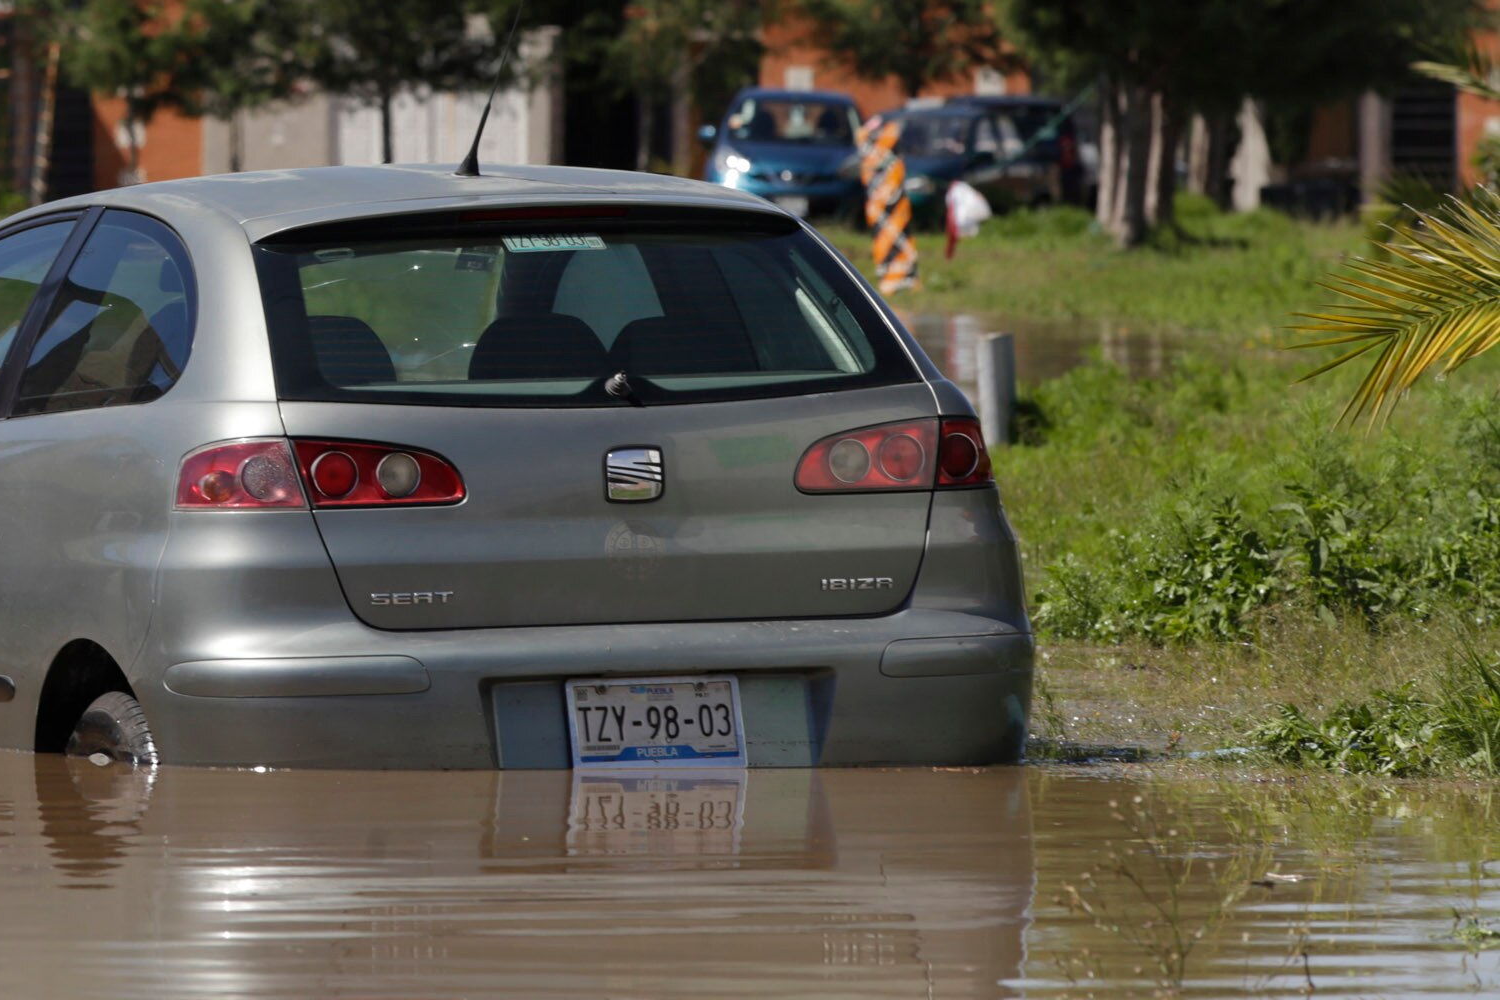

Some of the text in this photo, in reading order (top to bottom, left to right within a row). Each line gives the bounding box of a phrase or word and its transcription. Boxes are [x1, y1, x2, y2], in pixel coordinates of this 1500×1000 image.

[821, 577, 893, 590] IBIZA
[370, 591, 454, 605] SEAT
[577, 704, 732, 742] TZY-98-03
[636, 747, 679, 758] PUEBLA
